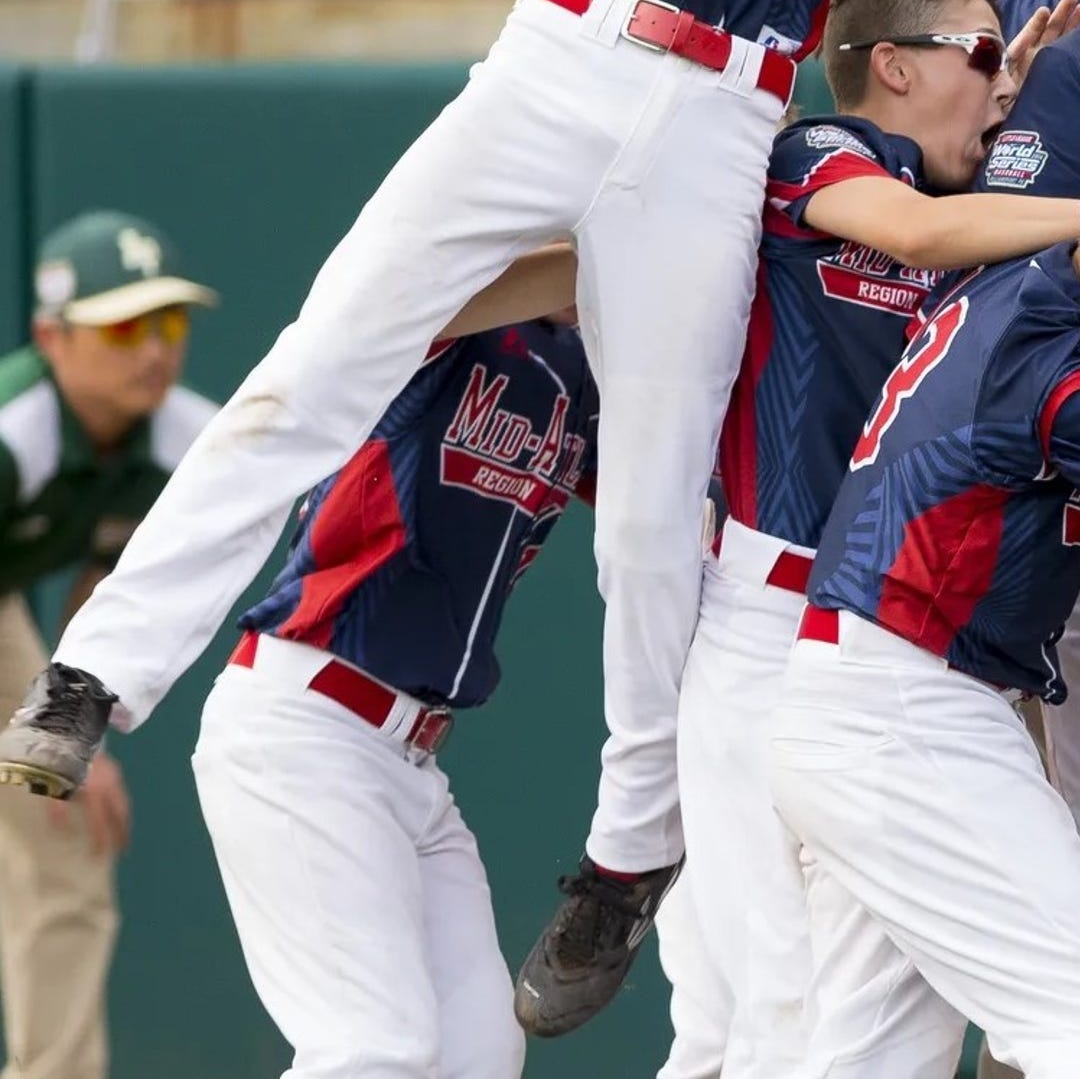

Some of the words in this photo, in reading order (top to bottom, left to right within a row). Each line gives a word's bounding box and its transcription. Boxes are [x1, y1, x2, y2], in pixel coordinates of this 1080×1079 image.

[993, 142, 1037, 158] World
[990, 156, 1041, 172] Series
[857, 281, 919, 309] REGION
[472, 466, 536, 501] REGION
